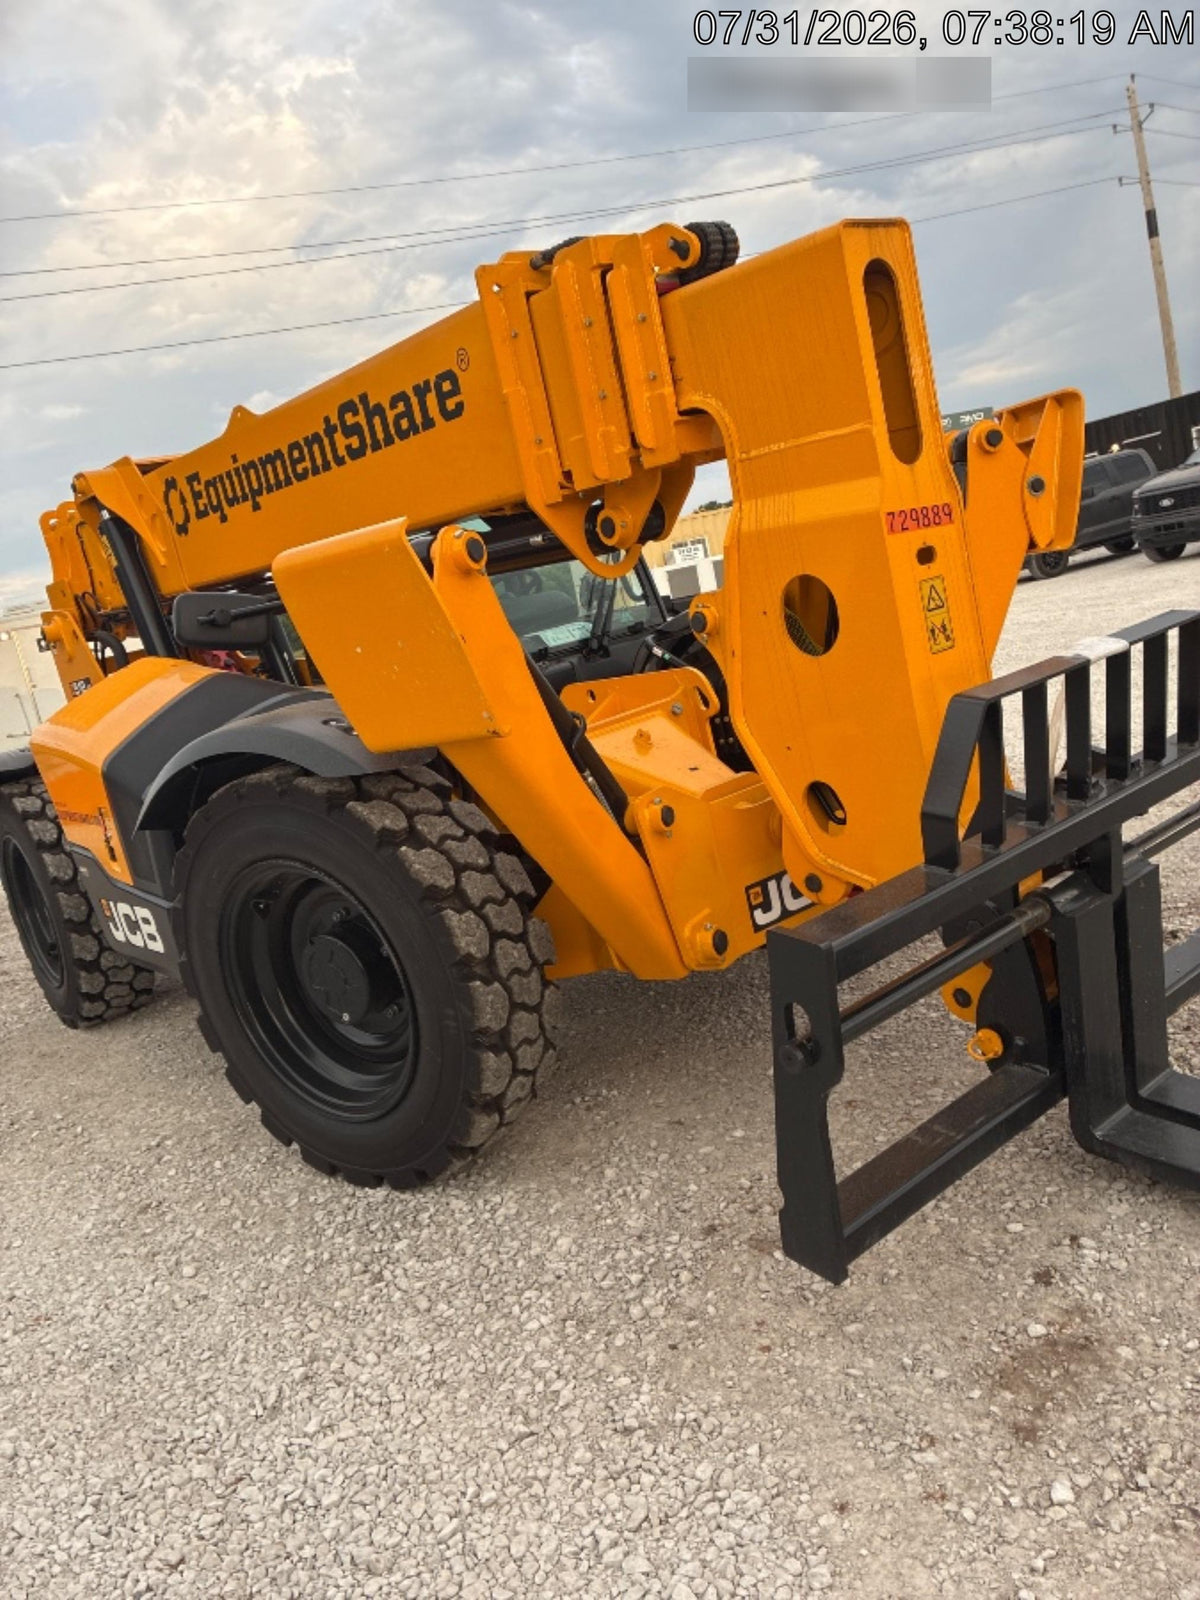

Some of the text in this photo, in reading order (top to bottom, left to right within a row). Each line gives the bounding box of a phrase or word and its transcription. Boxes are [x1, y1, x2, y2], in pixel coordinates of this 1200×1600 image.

[886, 502, 953, 533] 729889
[753, 872, 813, 926] JC
[109, 900, 165, 953] JCB
